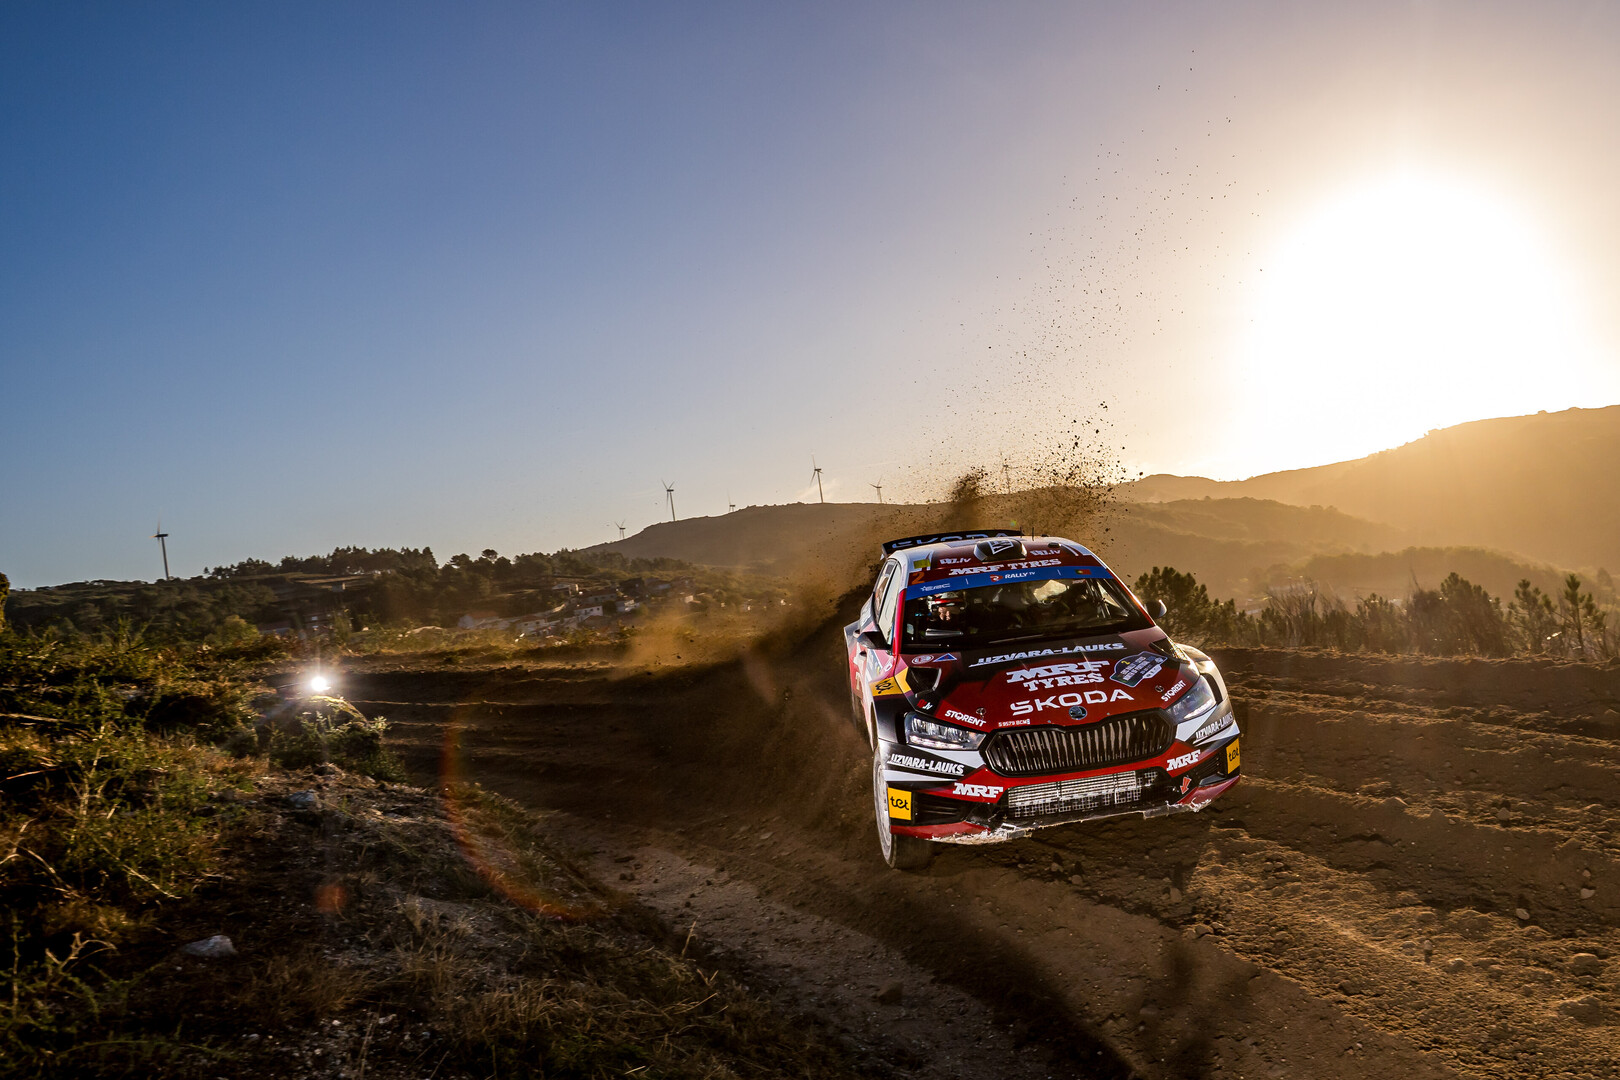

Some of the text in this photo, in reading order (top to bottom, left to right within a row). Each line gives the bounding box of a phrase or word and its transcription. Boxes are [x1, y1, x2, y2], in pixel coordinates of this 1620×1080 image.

[949, 558, 1062, 576] MRF TYRES
[911, 571, 926, 585] 2
[1006, 660, 1110, 684] MRF
[1023, 673, 1105, 692] TYRES
[1010, 689, 1134, 716] SKODA
[944, 709, 987, 727] STORENT
[1166, 749, 1201, 772] MRF
[952, 782, 1004, 798] MRF
[889, 796, 910, 811] tet
